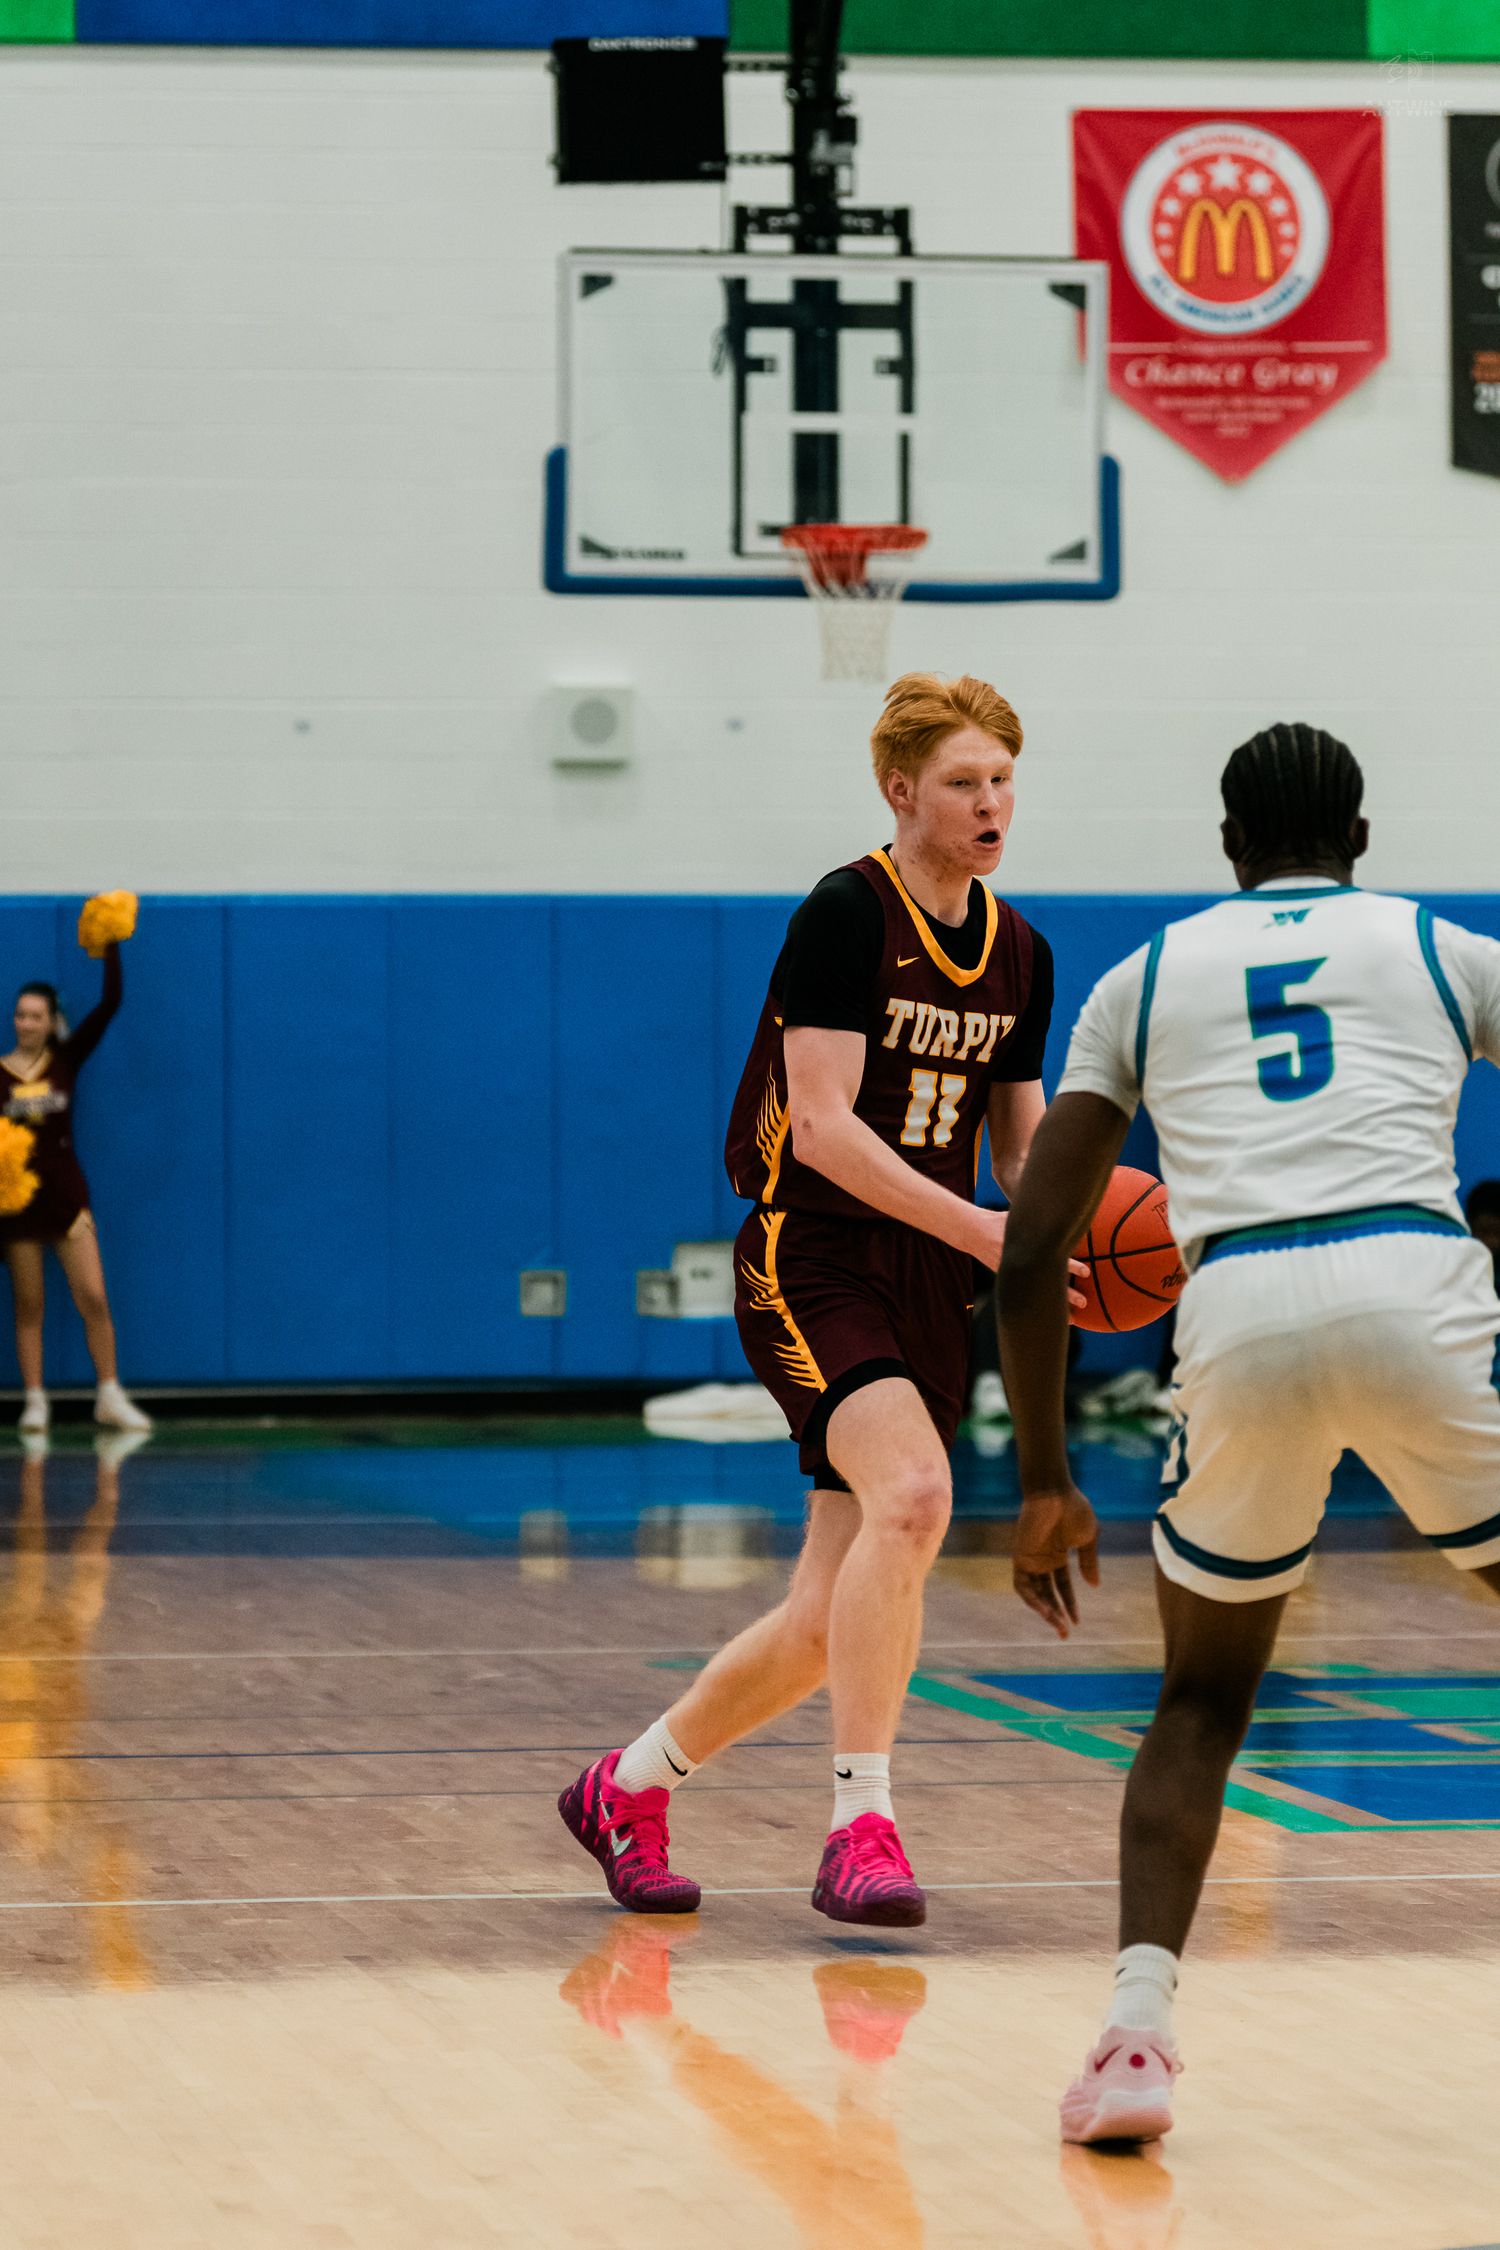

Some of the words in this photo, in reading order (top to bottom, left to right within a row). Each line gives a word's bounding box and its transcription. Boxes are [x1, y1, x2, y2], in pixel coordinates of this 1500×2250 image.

[1124, 355, 1246, 388] Chance
[1252, 357, 1338, 394] Gray
[1245, 956, 1335, 1102] 5
[900, 1068, 967, 1149] 11
